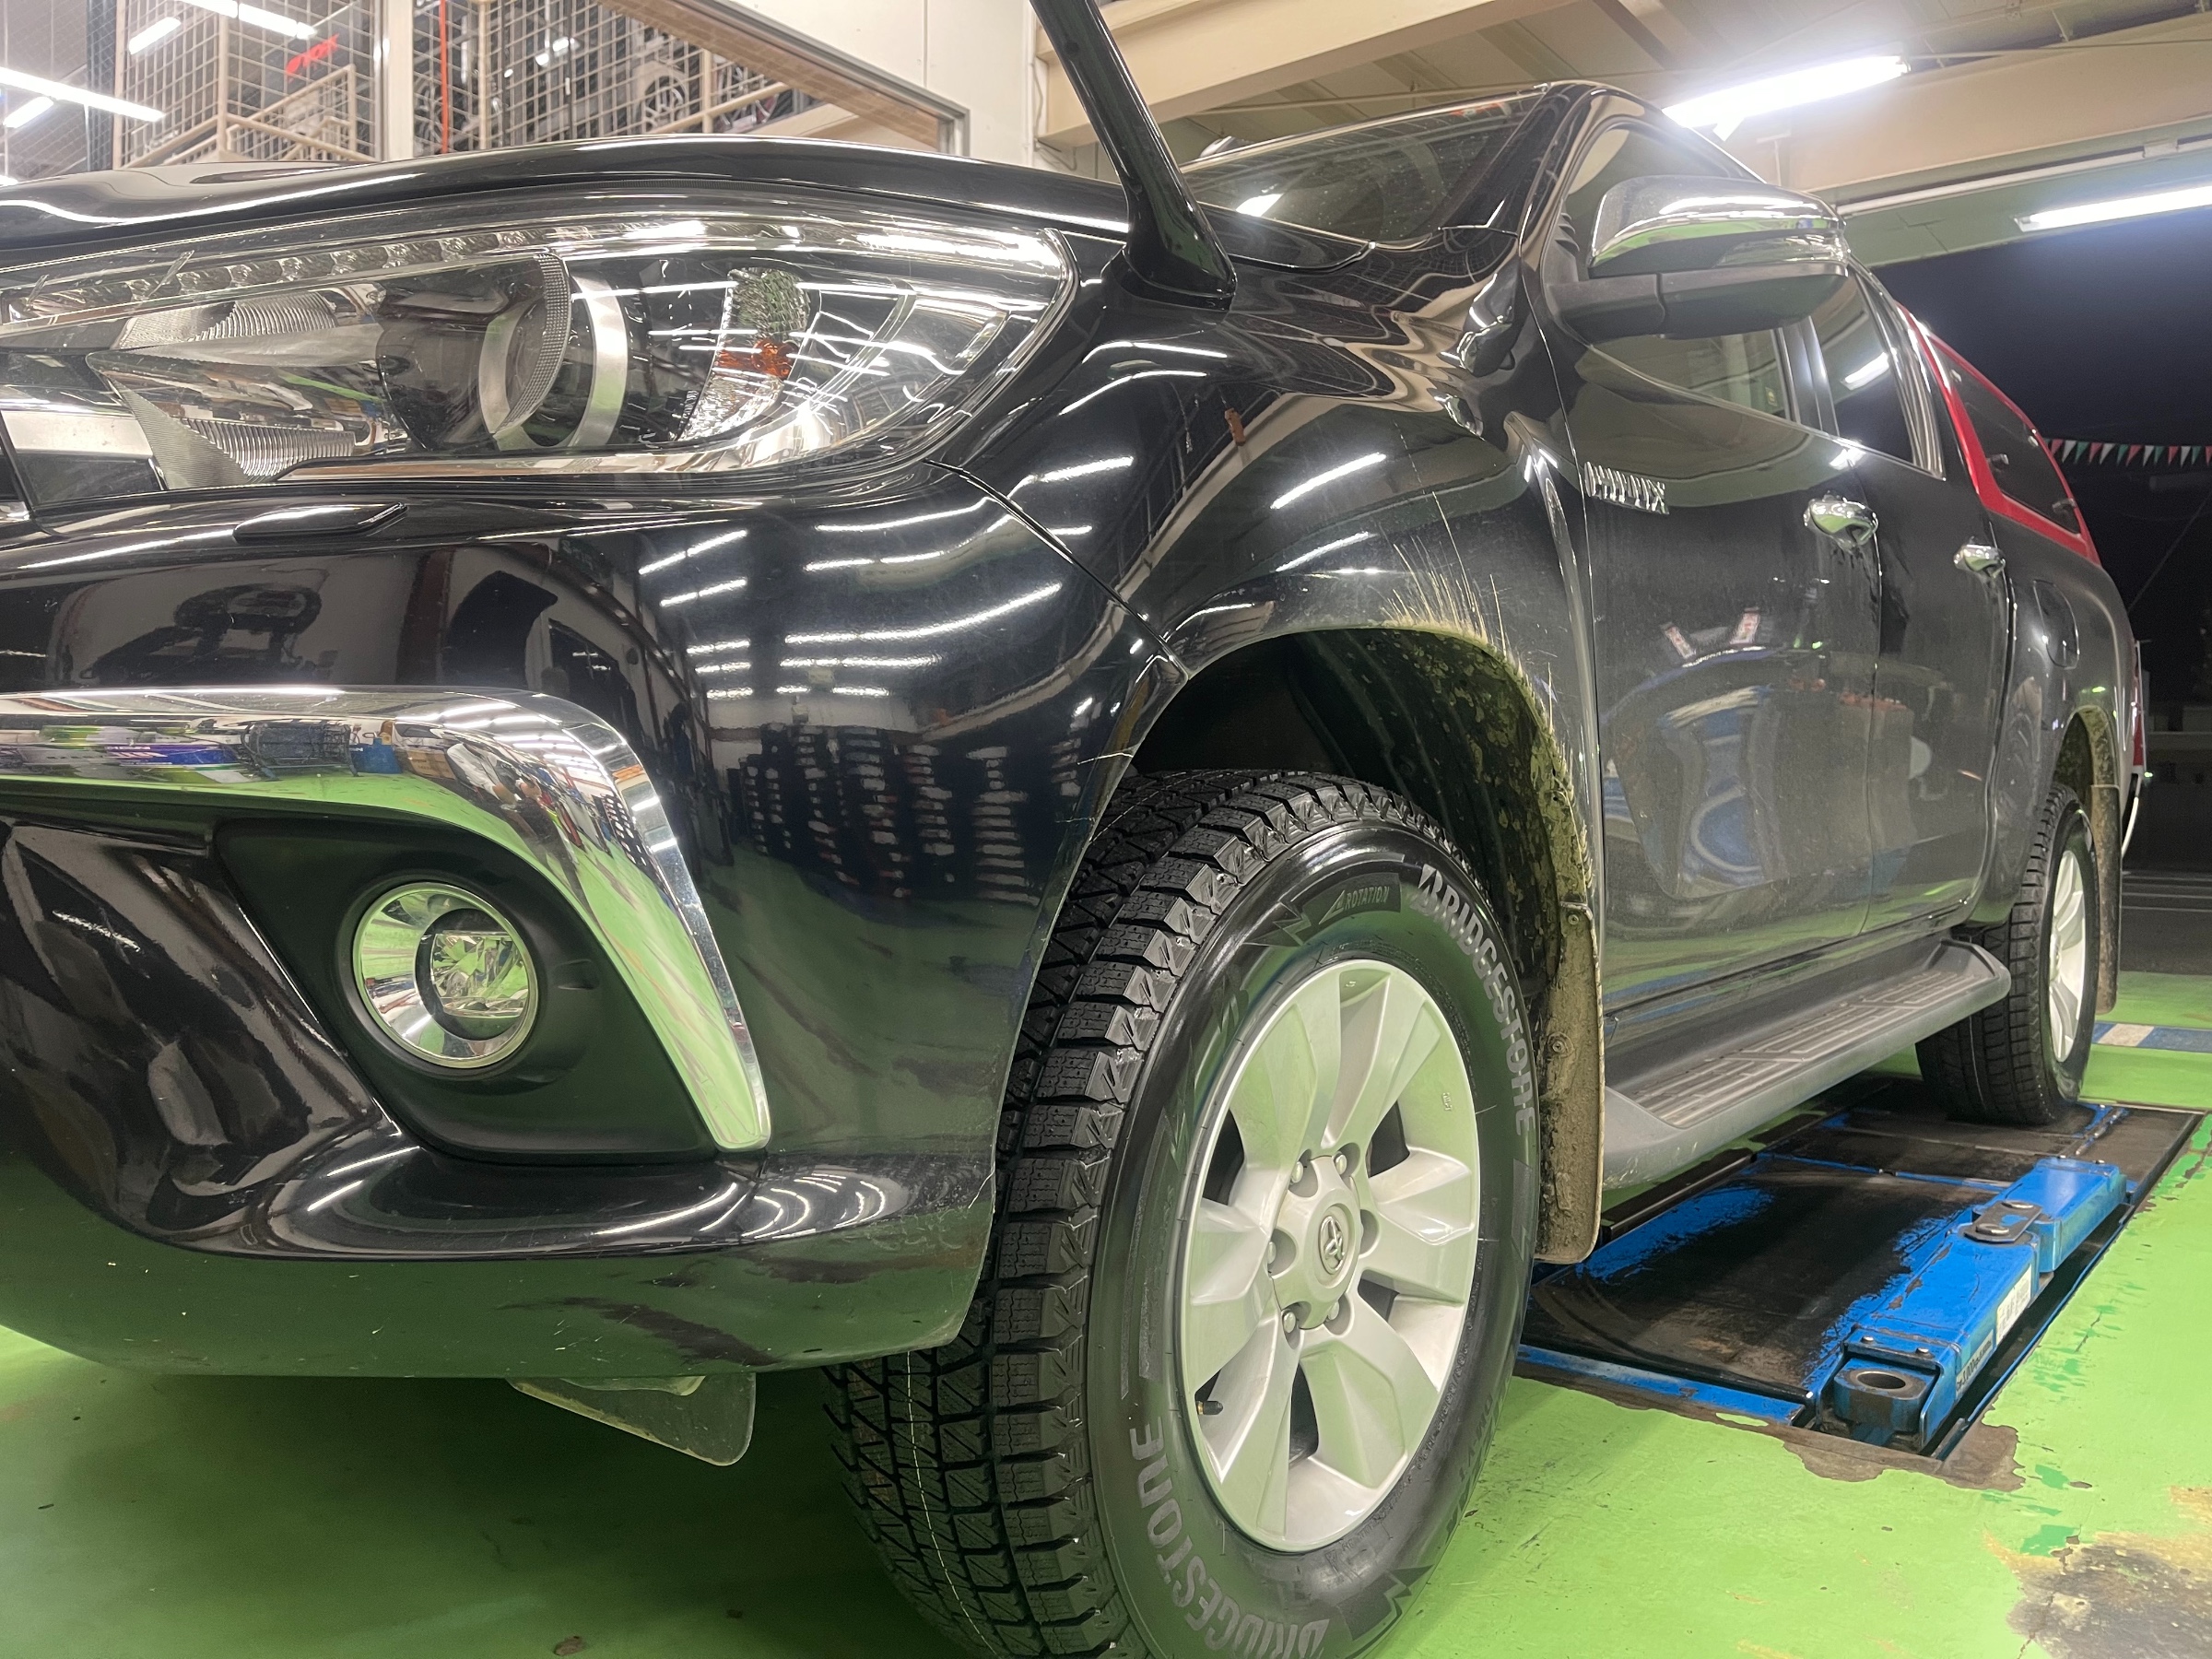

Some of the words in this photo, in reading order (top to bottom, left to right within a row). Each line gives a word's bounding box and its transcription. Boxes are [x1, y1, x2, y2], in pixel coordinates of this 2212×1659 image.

[1345, 886, 1390, 911] ROTATION
[1410, 864, 1535, 1135] BRIDGESTONE
[1128, 1416, 1330, 1659] BRIDGESTONE
